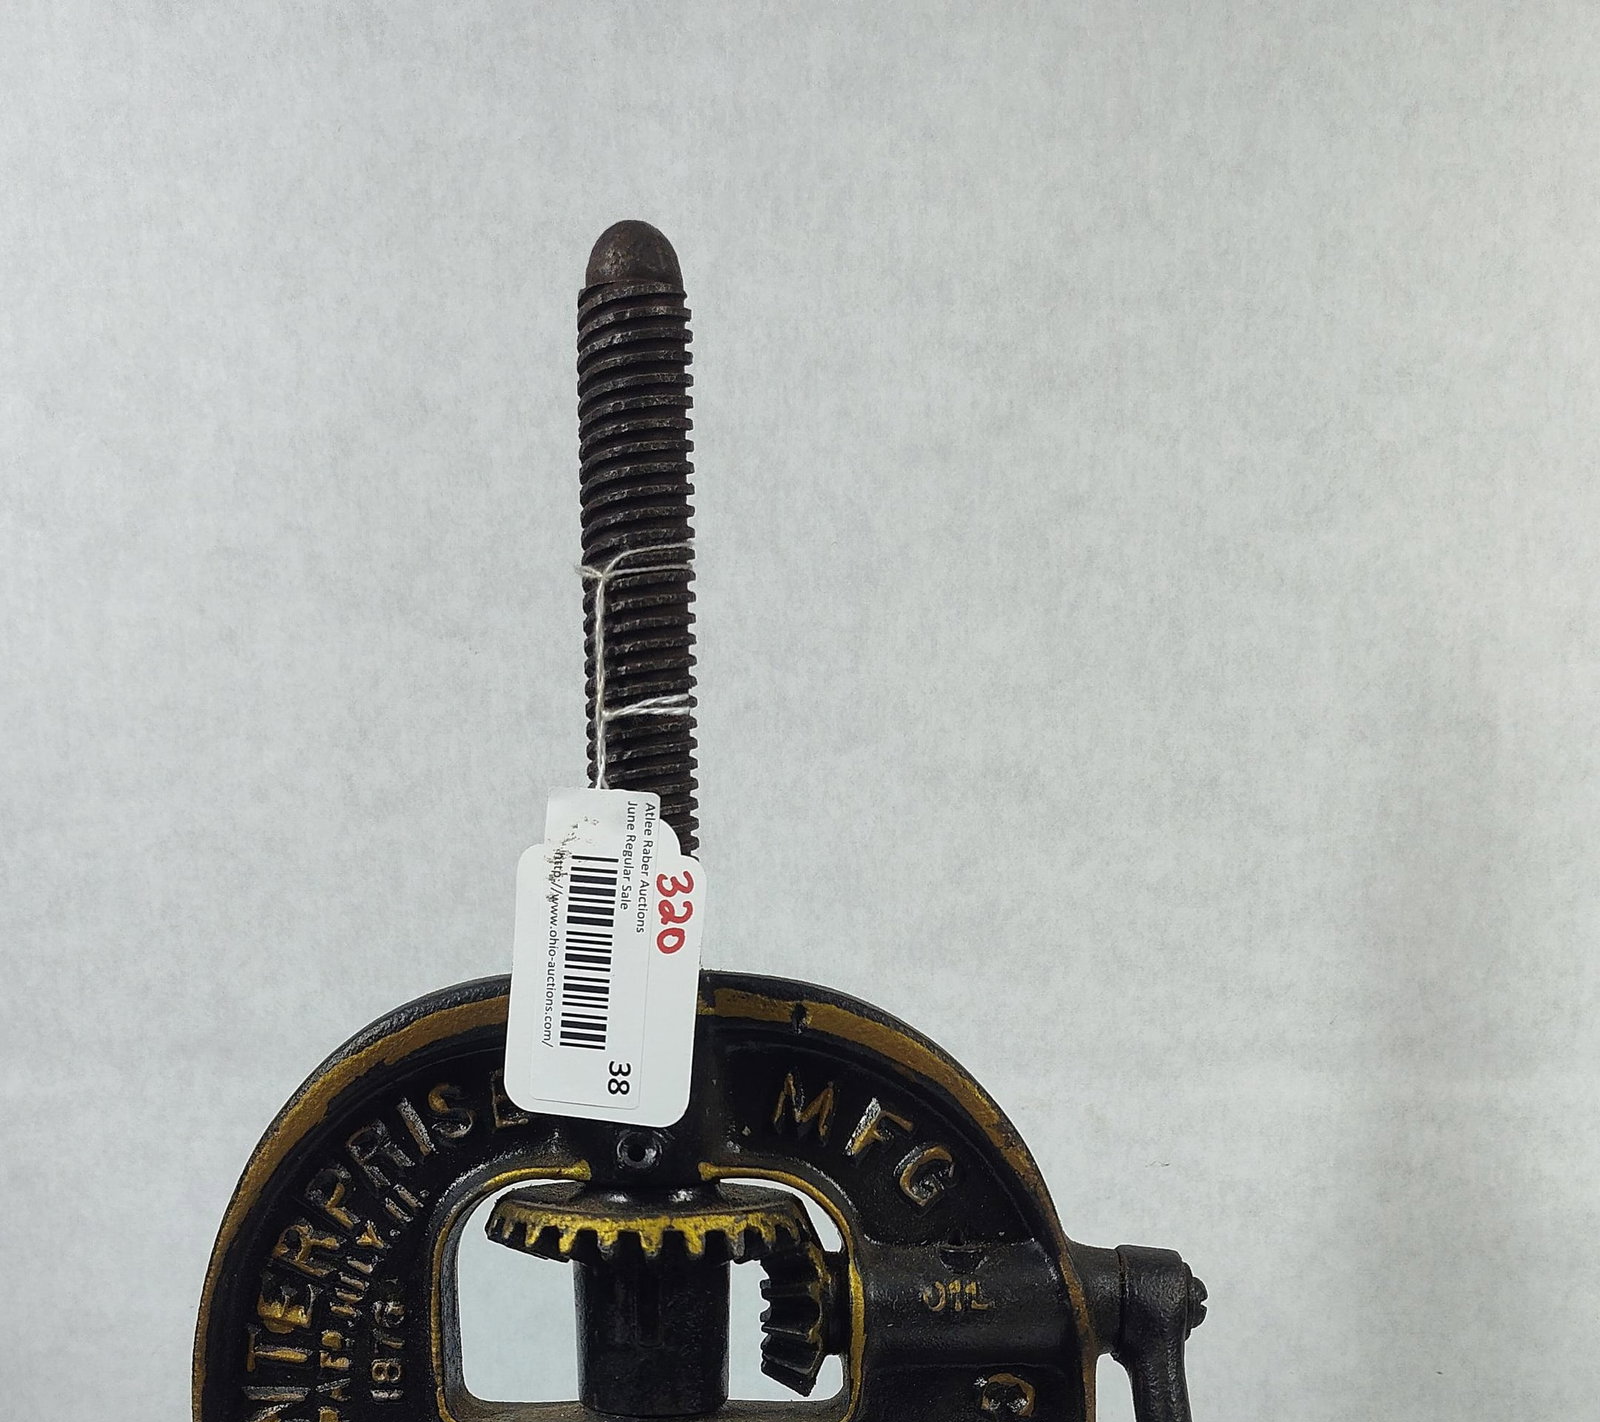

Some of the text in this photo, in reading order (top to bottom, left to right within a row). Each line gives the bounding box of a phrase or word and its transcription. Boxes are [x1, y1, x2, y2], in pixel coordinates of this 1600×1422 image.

[619, 800, 639, 911] June Regular Sale
[635, 801, 657, 934] Atlee Raber Auctions
[656, 870, 694, 955] 320
[542, 851, 564, 1048] http://www.ohio-auctions.com/
[608, 1060, 632, 1096] 38
[773, 1071, 957, 1207] MFG
